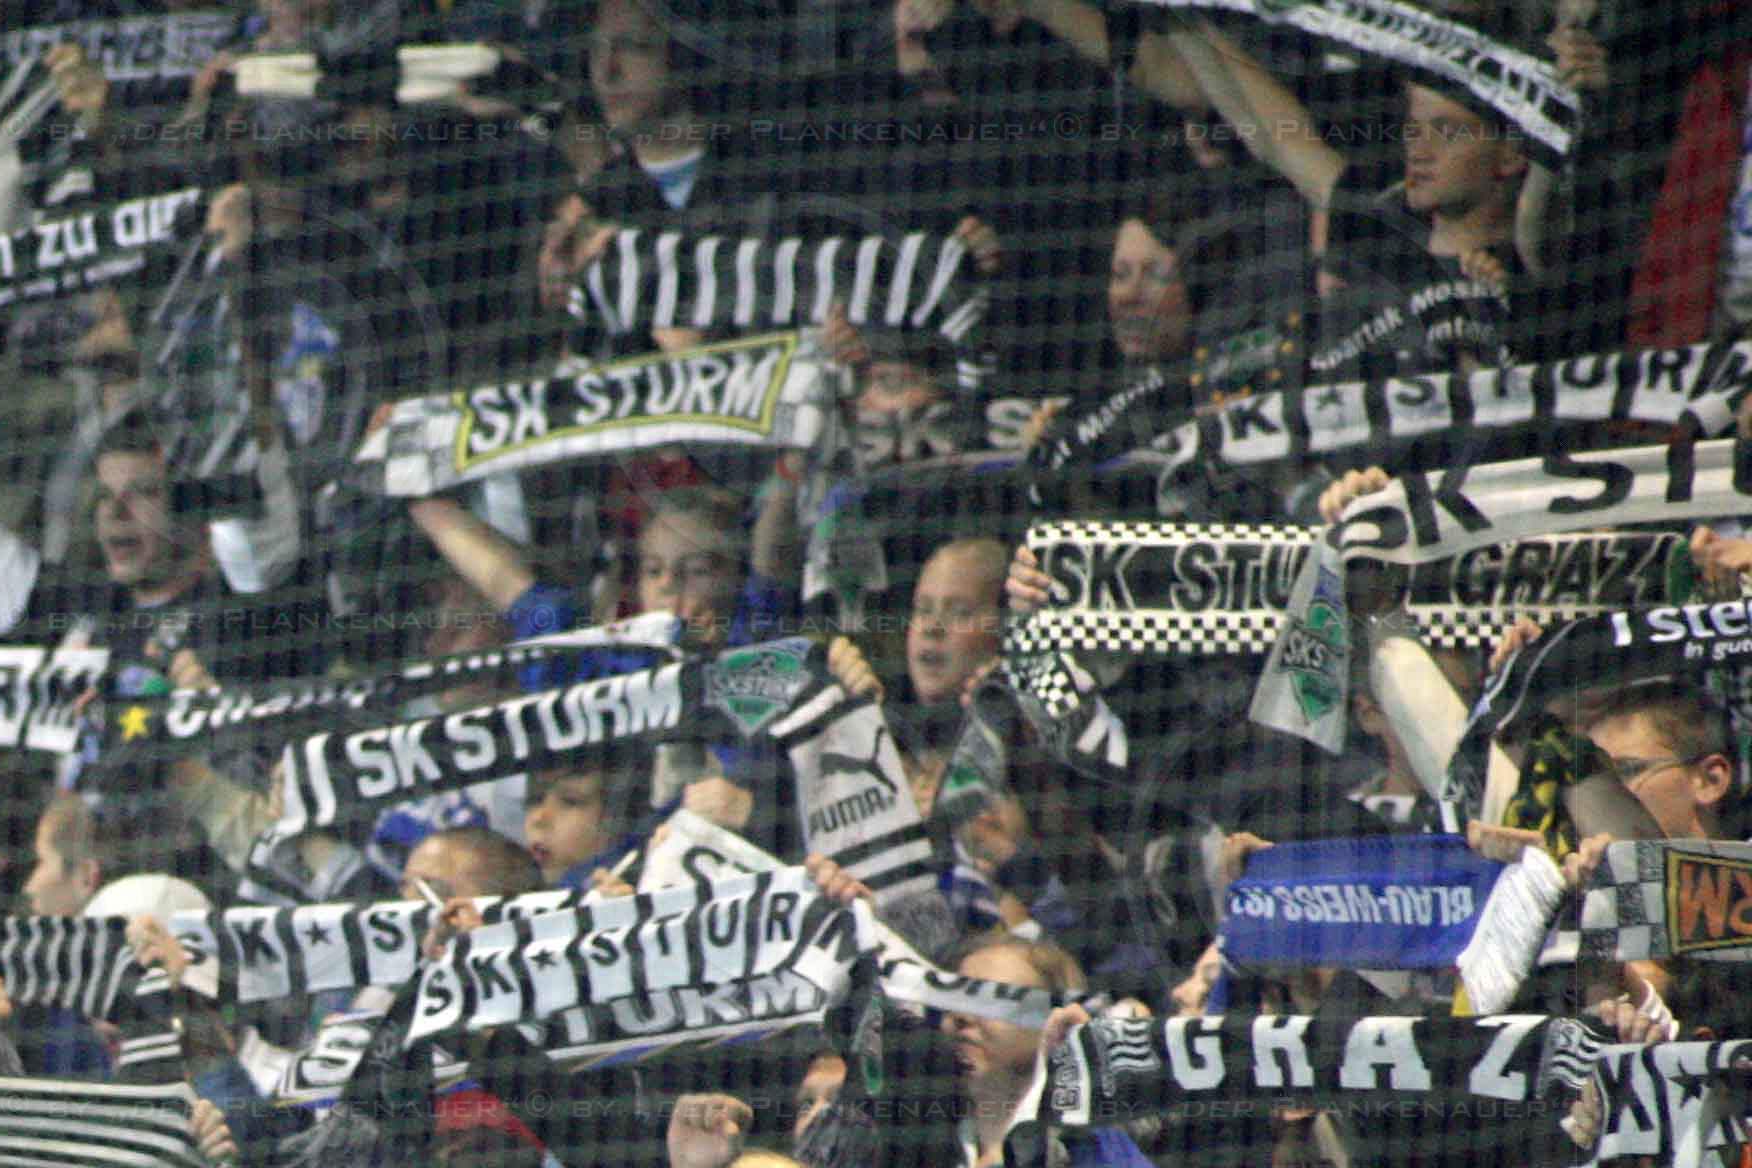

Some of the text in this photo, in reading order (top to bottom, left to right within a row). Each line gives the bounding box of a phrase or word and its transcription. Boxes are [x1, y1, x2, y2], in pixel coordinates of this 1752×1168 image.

[574, 340, 783, 421] STURM
[344, 660, 688, 800] SK STURM
